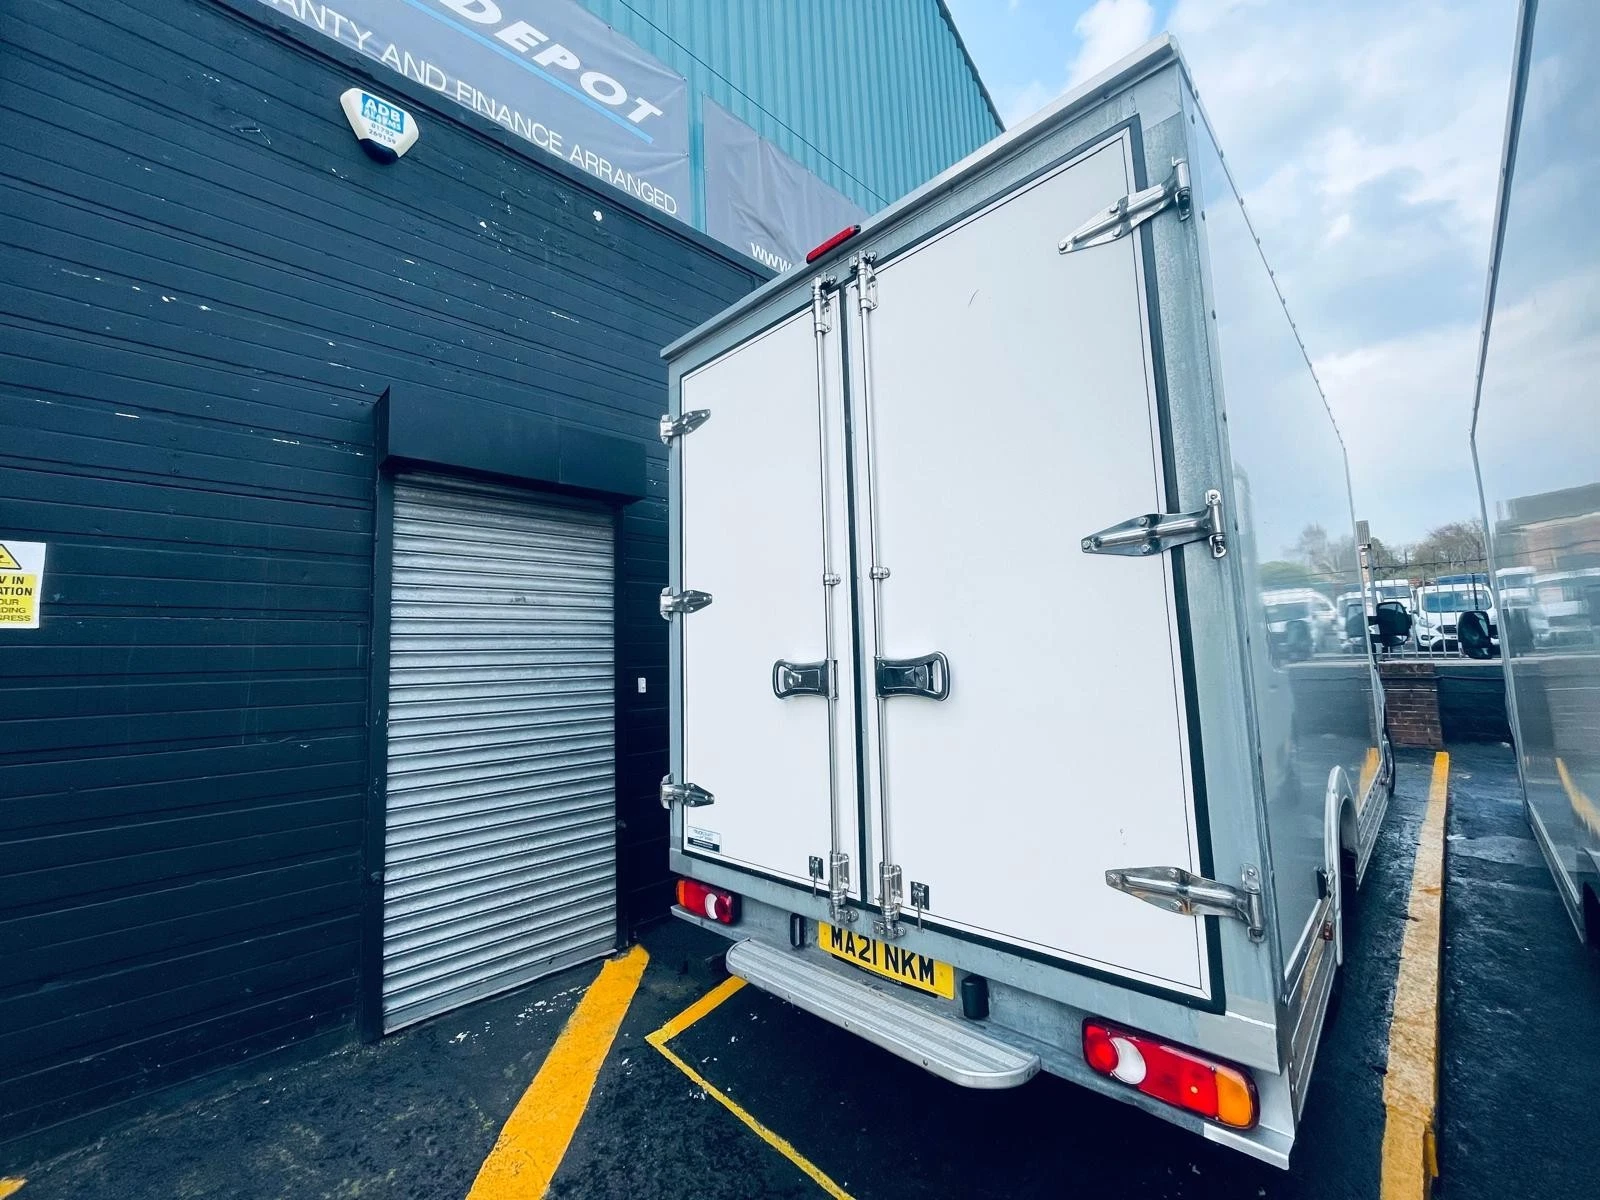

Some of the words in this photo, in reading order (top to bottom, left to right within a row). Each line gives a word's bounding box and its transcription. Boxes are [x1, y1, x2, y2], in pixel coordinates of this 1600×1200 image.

[439, 0, 664, 124] DEPOT
[271, 0, 373, 50] ANTY
[381, 43, 447, 92] AND
[457, 79, 563, 156] FINANCE
[569, 144, 677, 215] ARRANGED
[364, 98, 401, 122] ADB
[12, 576, 25, 585] IN
[830, 925, 877, 966] MA21
[884, 943, 935, 986] NKM
